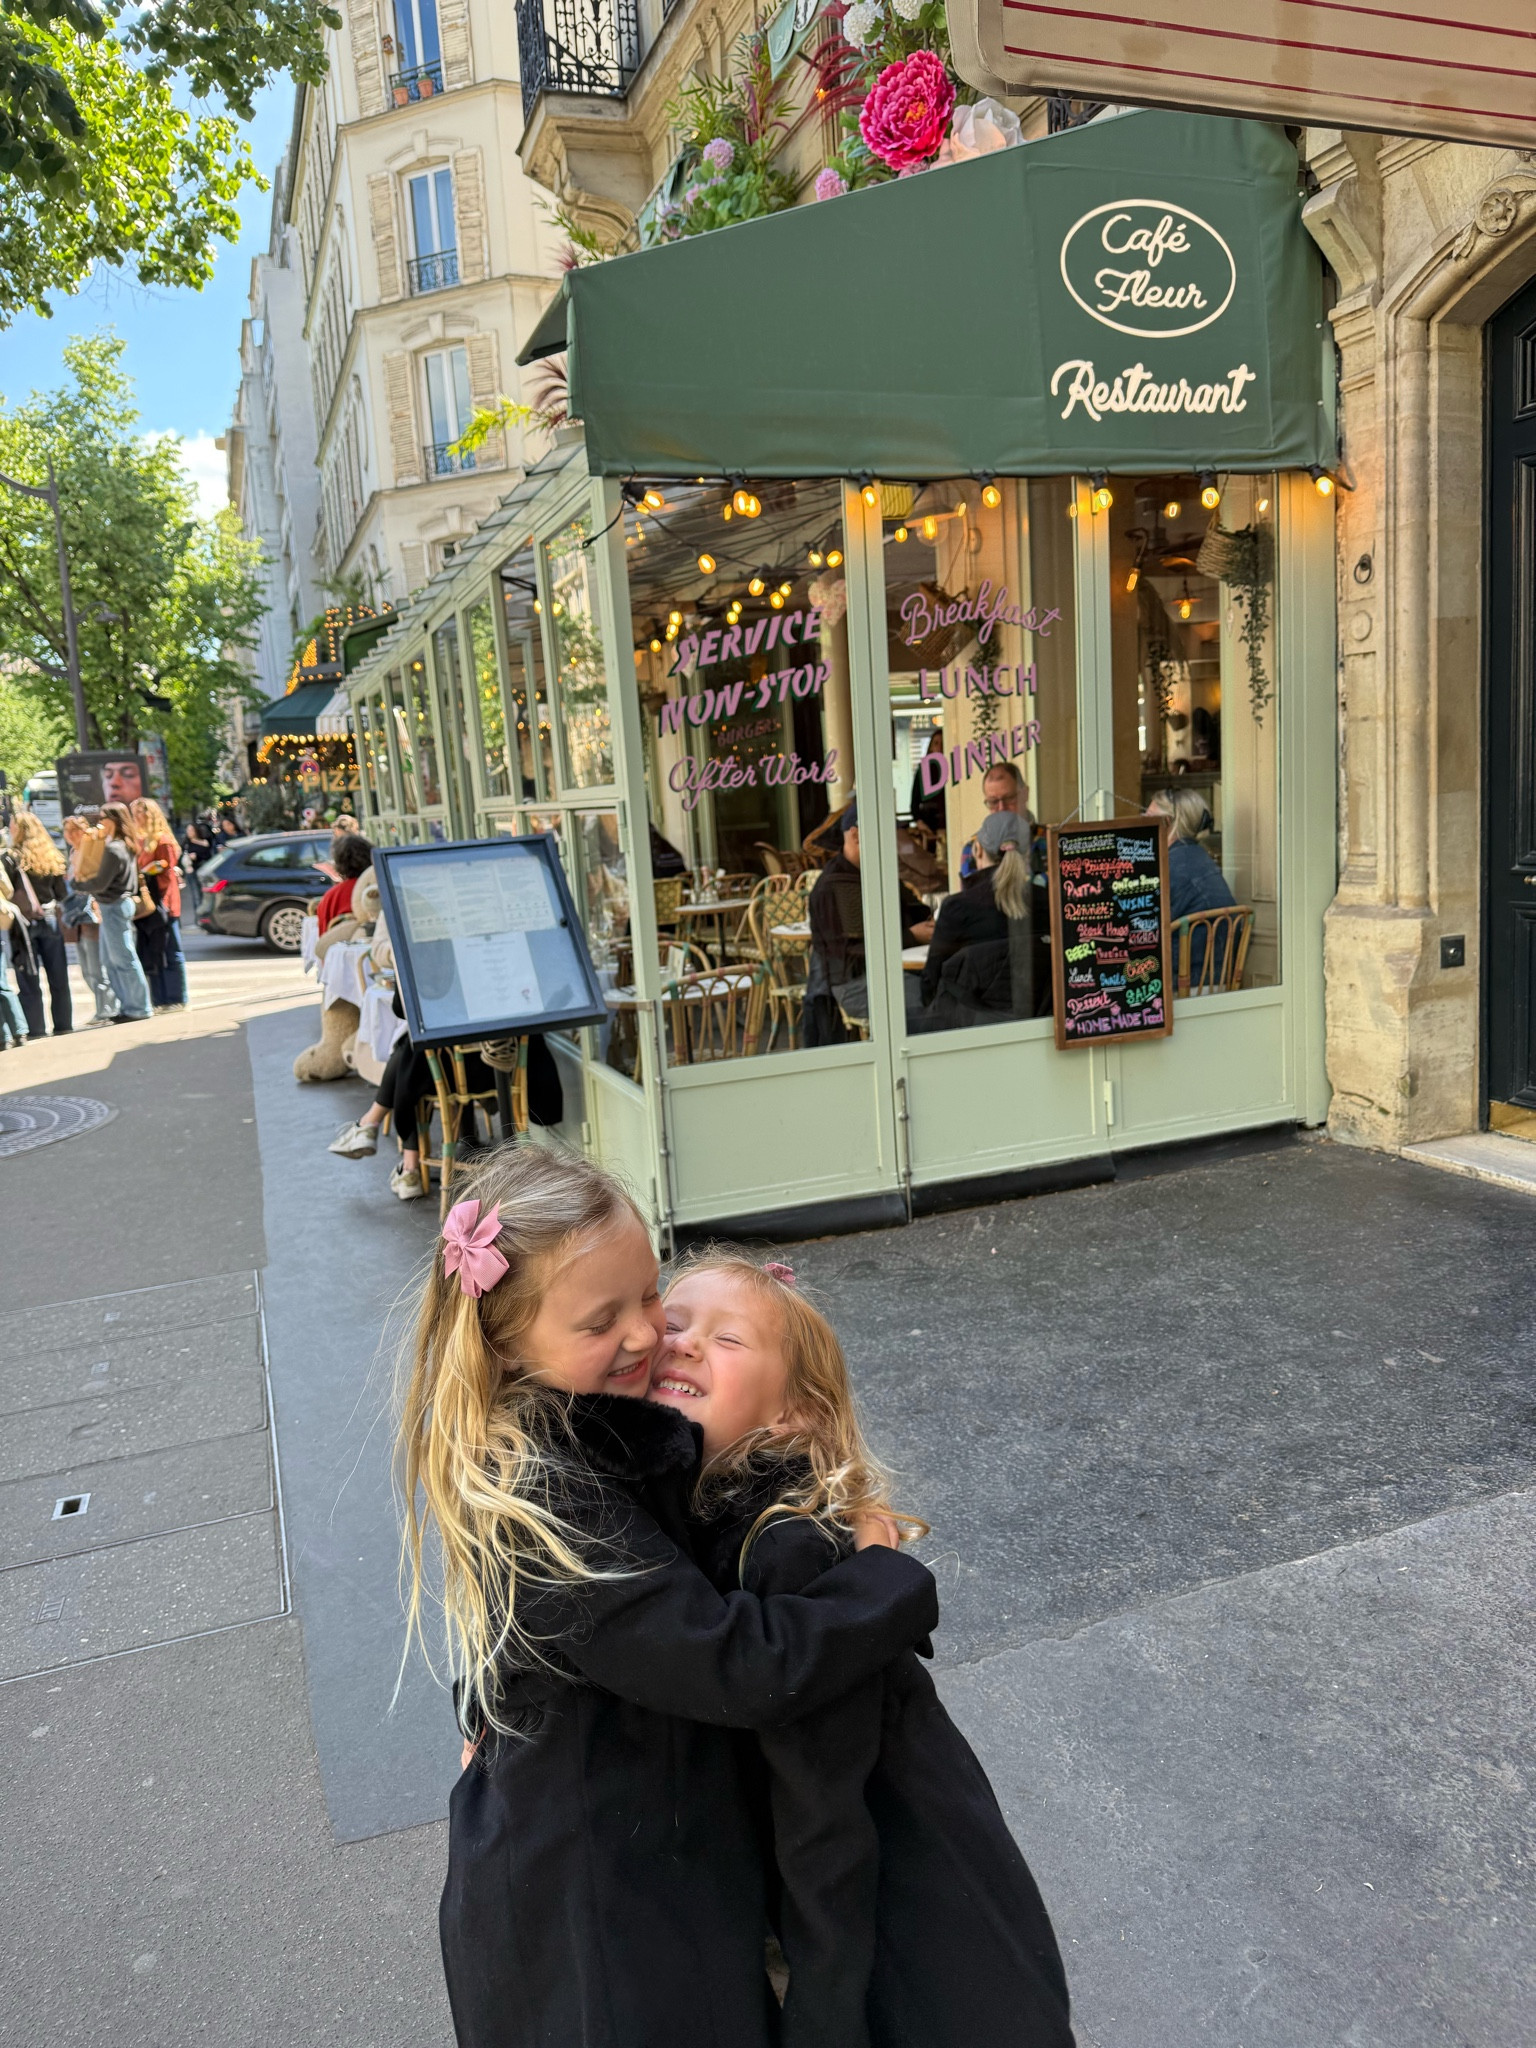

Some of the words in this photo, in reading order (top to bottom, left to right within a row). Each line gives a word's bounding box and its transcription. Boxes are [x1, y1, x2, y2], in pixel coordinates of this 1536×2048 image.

[1101, 213, 1191, 267] Café
[1094, 267, 1208, 312] Fleur
[1051, 359, 1256, 422] Restaurant
[669, 606, 824, 676] SERVICE
[900, 579, 1062, 646] Breakfast
[660, 659, 832, 736] NON-STOP
[919, 663, 1037, 699] LUNCH
[759, 749, 840, 787] Work
[920, 720, 1041, 799] DINNER
